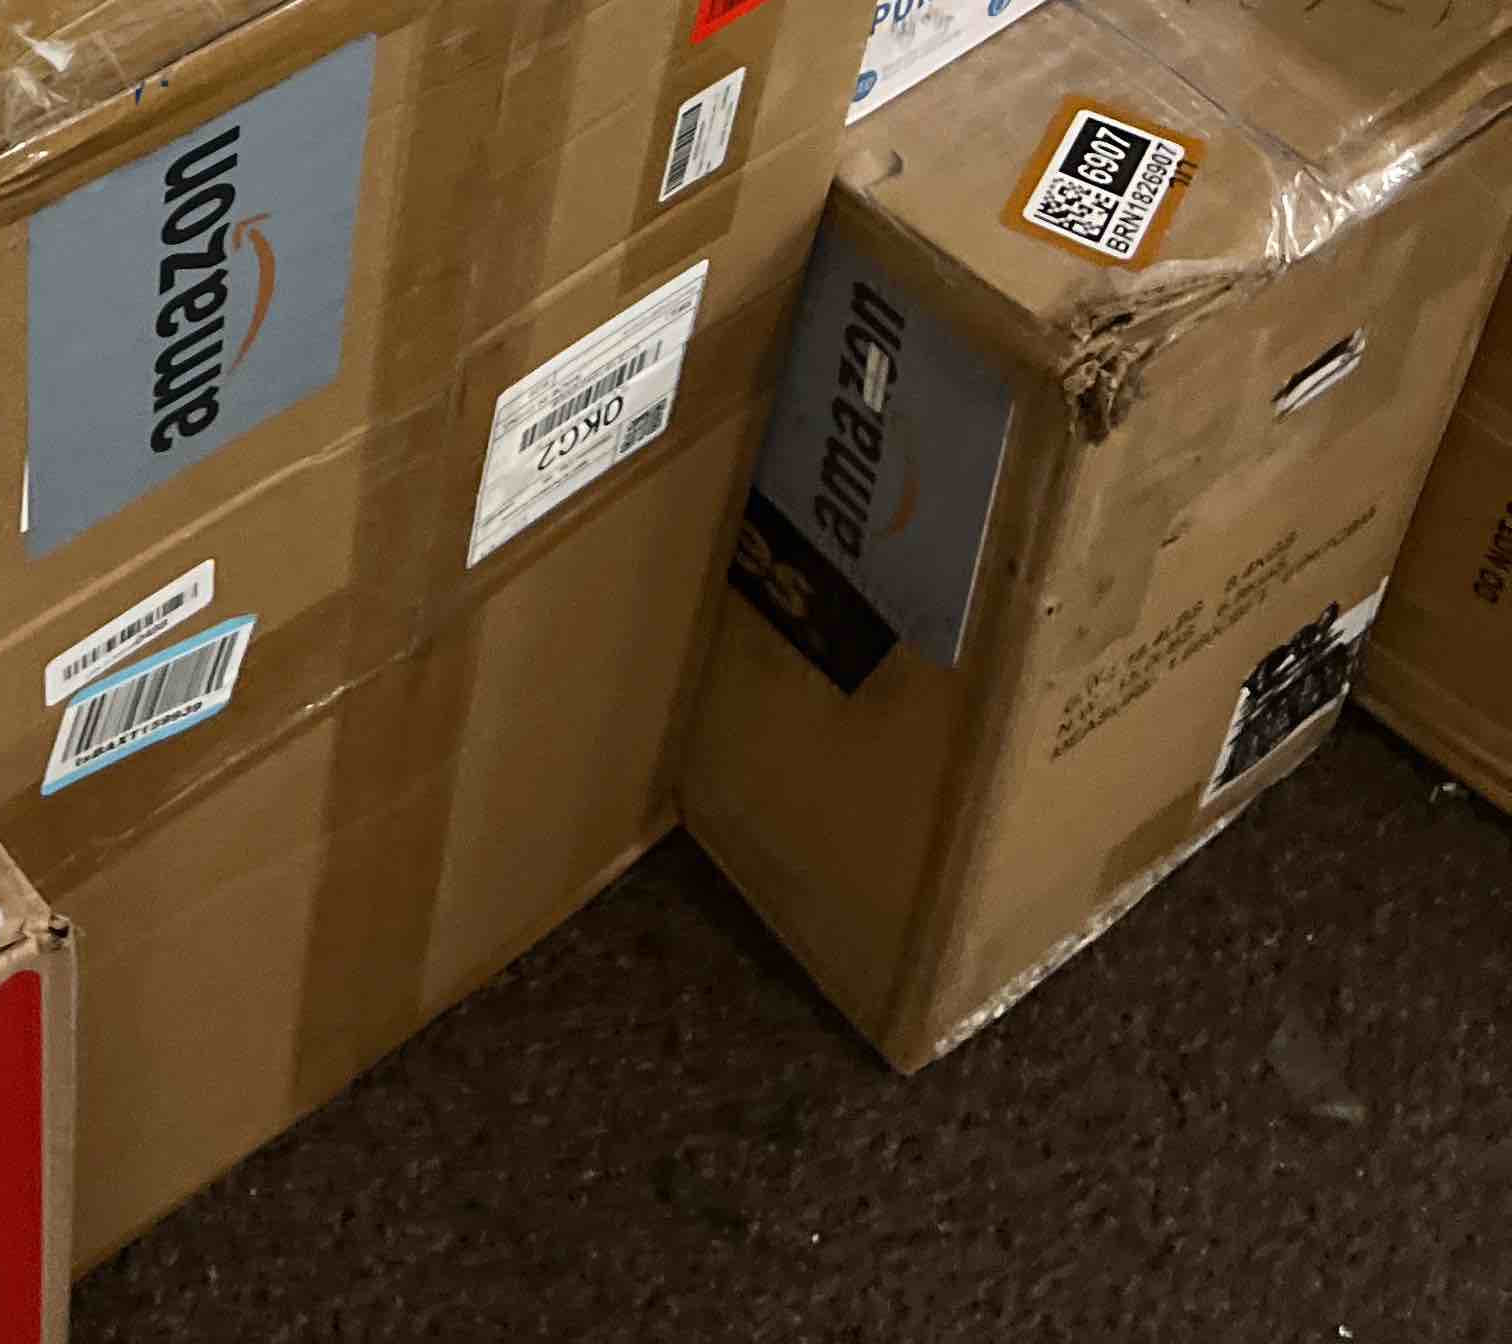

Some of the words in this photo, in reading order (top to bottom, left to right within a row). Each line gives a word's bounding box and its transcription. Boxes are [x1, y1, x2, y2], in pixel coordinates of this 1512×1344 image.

[1076, 125, 1134, 186] 6907
[1106, 141, 1179, 254] BRN1826907
[149, 122, 241, 455] amazon
[813, 279, 907, 563] amazon
